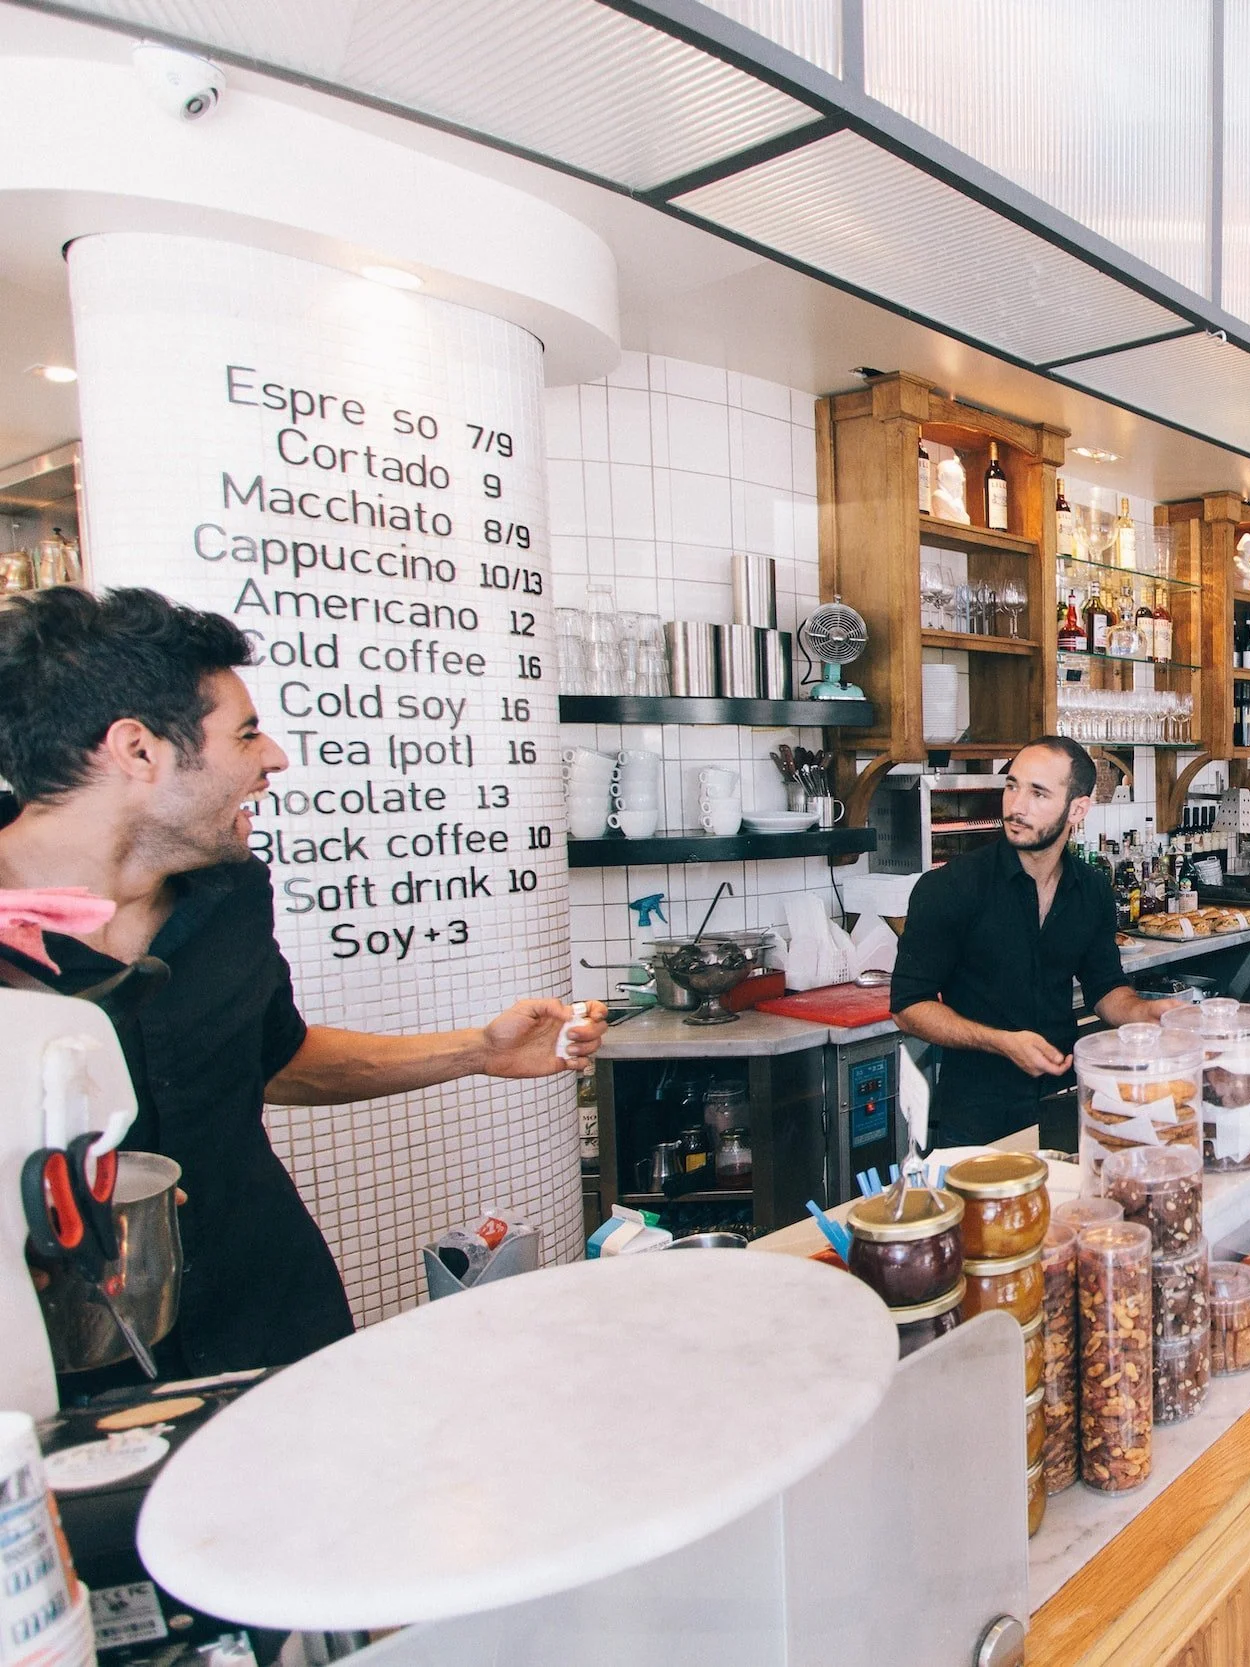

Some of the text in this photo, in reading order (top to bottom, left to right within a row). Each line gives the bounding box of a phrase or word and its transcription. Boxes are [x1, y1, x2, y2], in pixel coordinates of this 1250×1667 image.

[466, 423, 513, 458] 7/9
[277, 428, 502, 499] Cortado 9
[222, 471, 531, 550] Macchiato 8/9
[193, 523, 543, 596] Cappuccino 10/13
[234, 577, 535, 637] Americano 12
[359, 638, 486, 677] coffee
[518, 655, 542, 679] 16
[280, 681, 530, 730] Cold soy 16
[287, 730, 371, 767] Tea
[508, 740, 537, 766] 16
[477, 784, 510, 810] 13
[387, 823, 509, 860] coffee
[528, 826, 551, 850] 10
[284, 866, 538, 914] Soft drink 10
[330, 923, 415, 961] Soy
